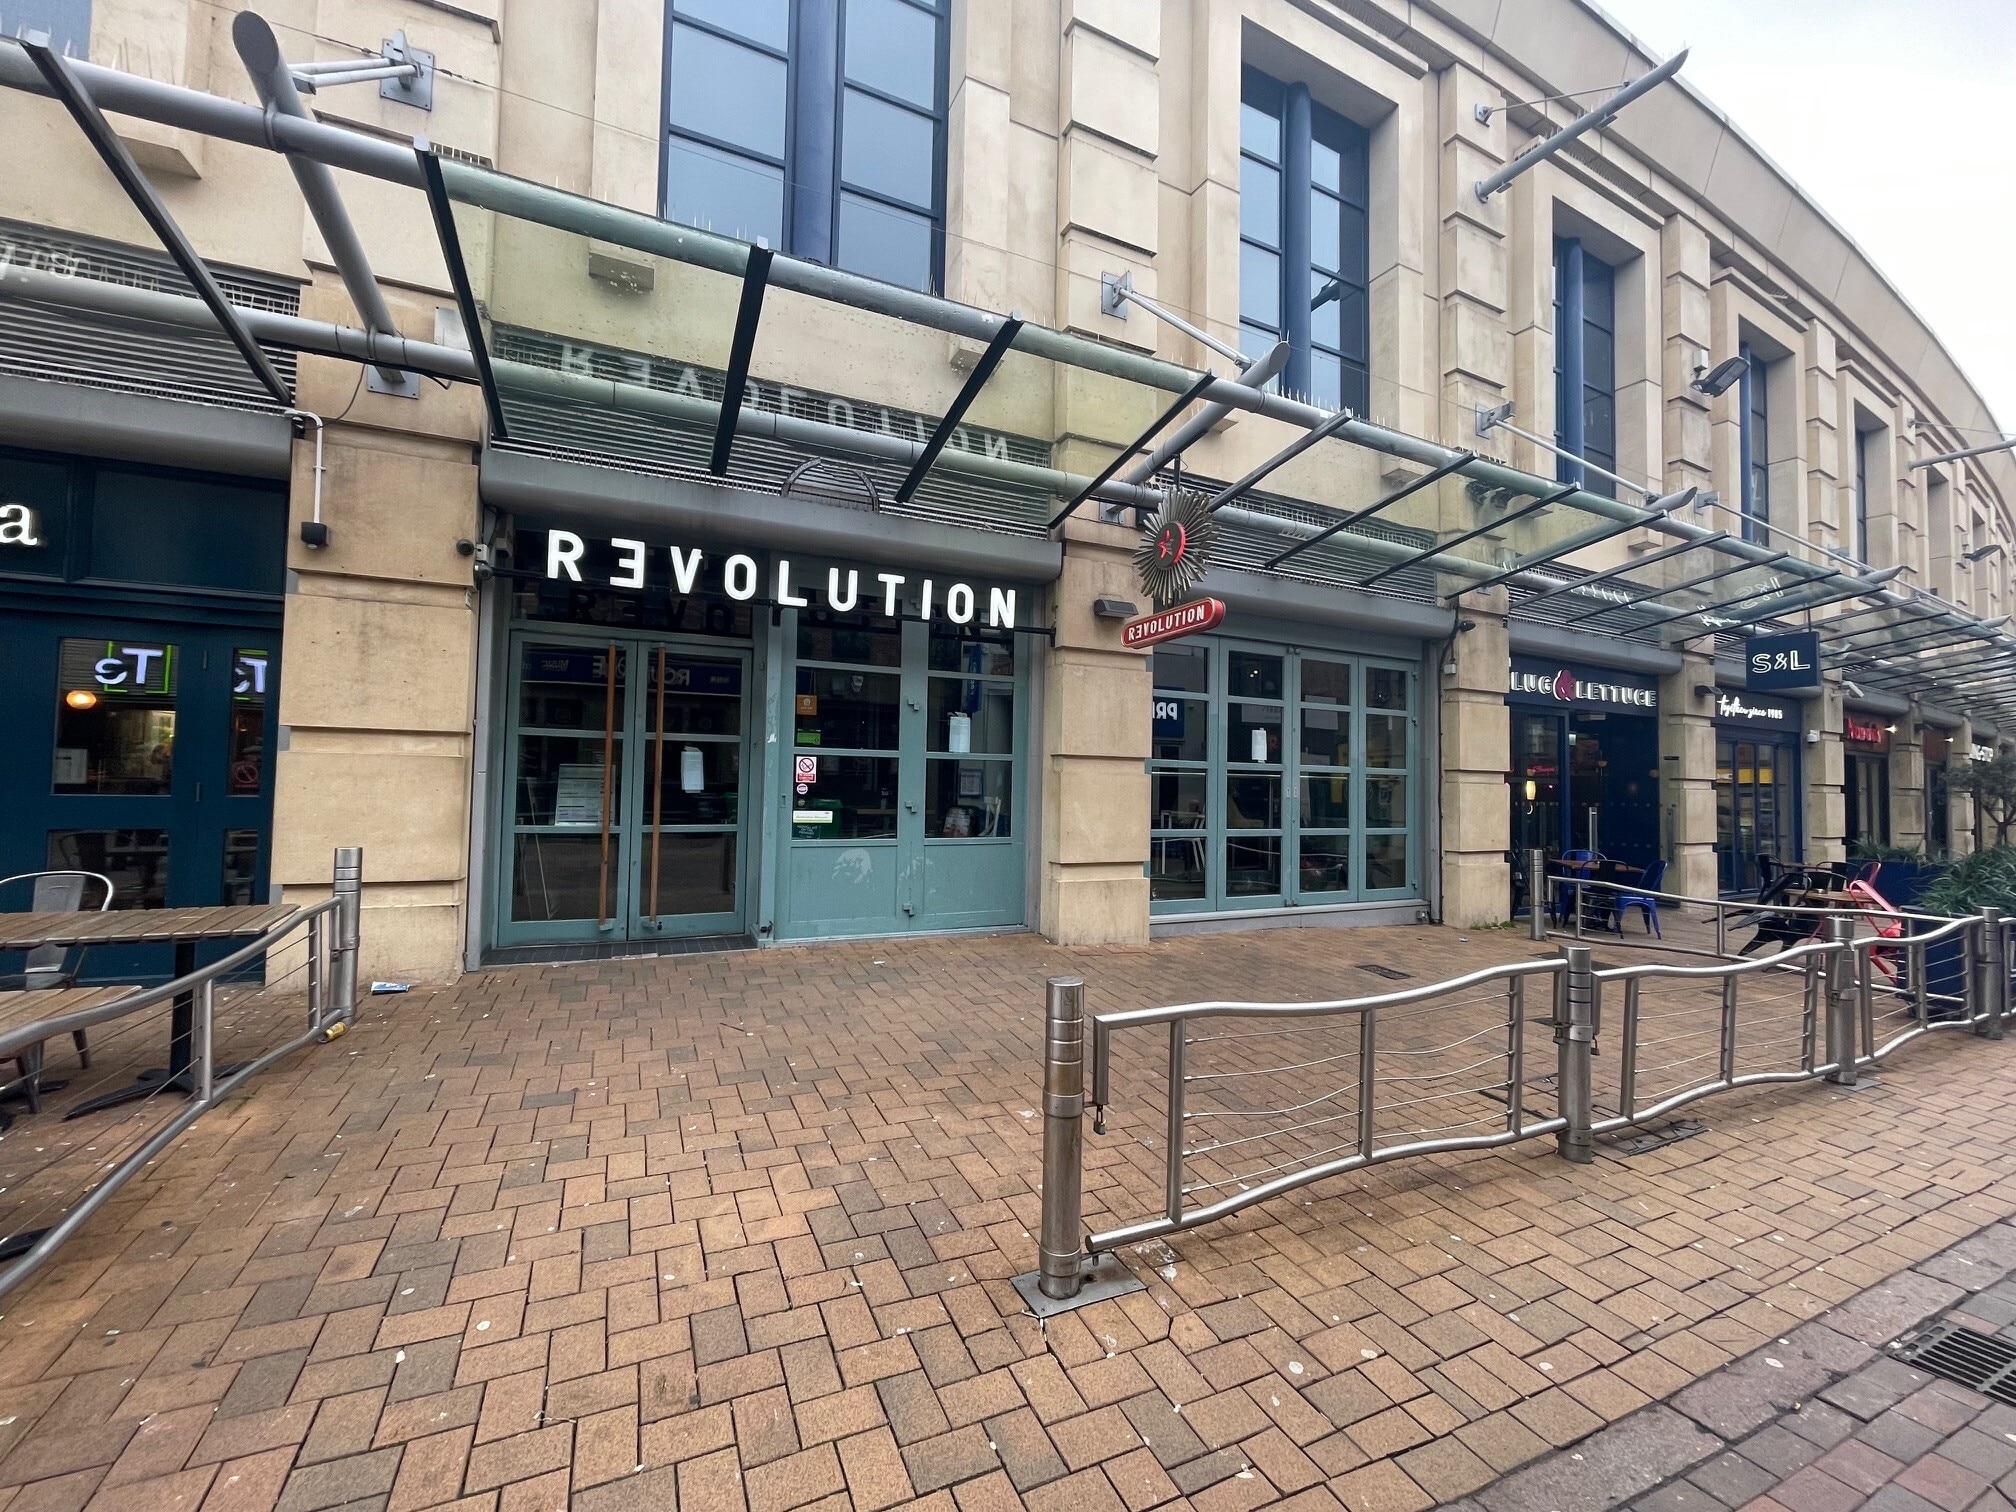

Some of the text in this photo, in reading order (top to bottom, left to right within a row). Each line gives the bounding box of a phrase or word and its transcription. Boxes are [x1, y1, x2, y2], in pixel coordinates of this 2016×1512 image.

[546, 528, 1017, 629] REVOLUTION
[1128, 604, 1205, 641] REVOLUTION
[1752, 649, 1811, 675] S&L
[1509, 671, 1553, 695] LUG
[1575, 680, 1657, 707] LETTUCE
